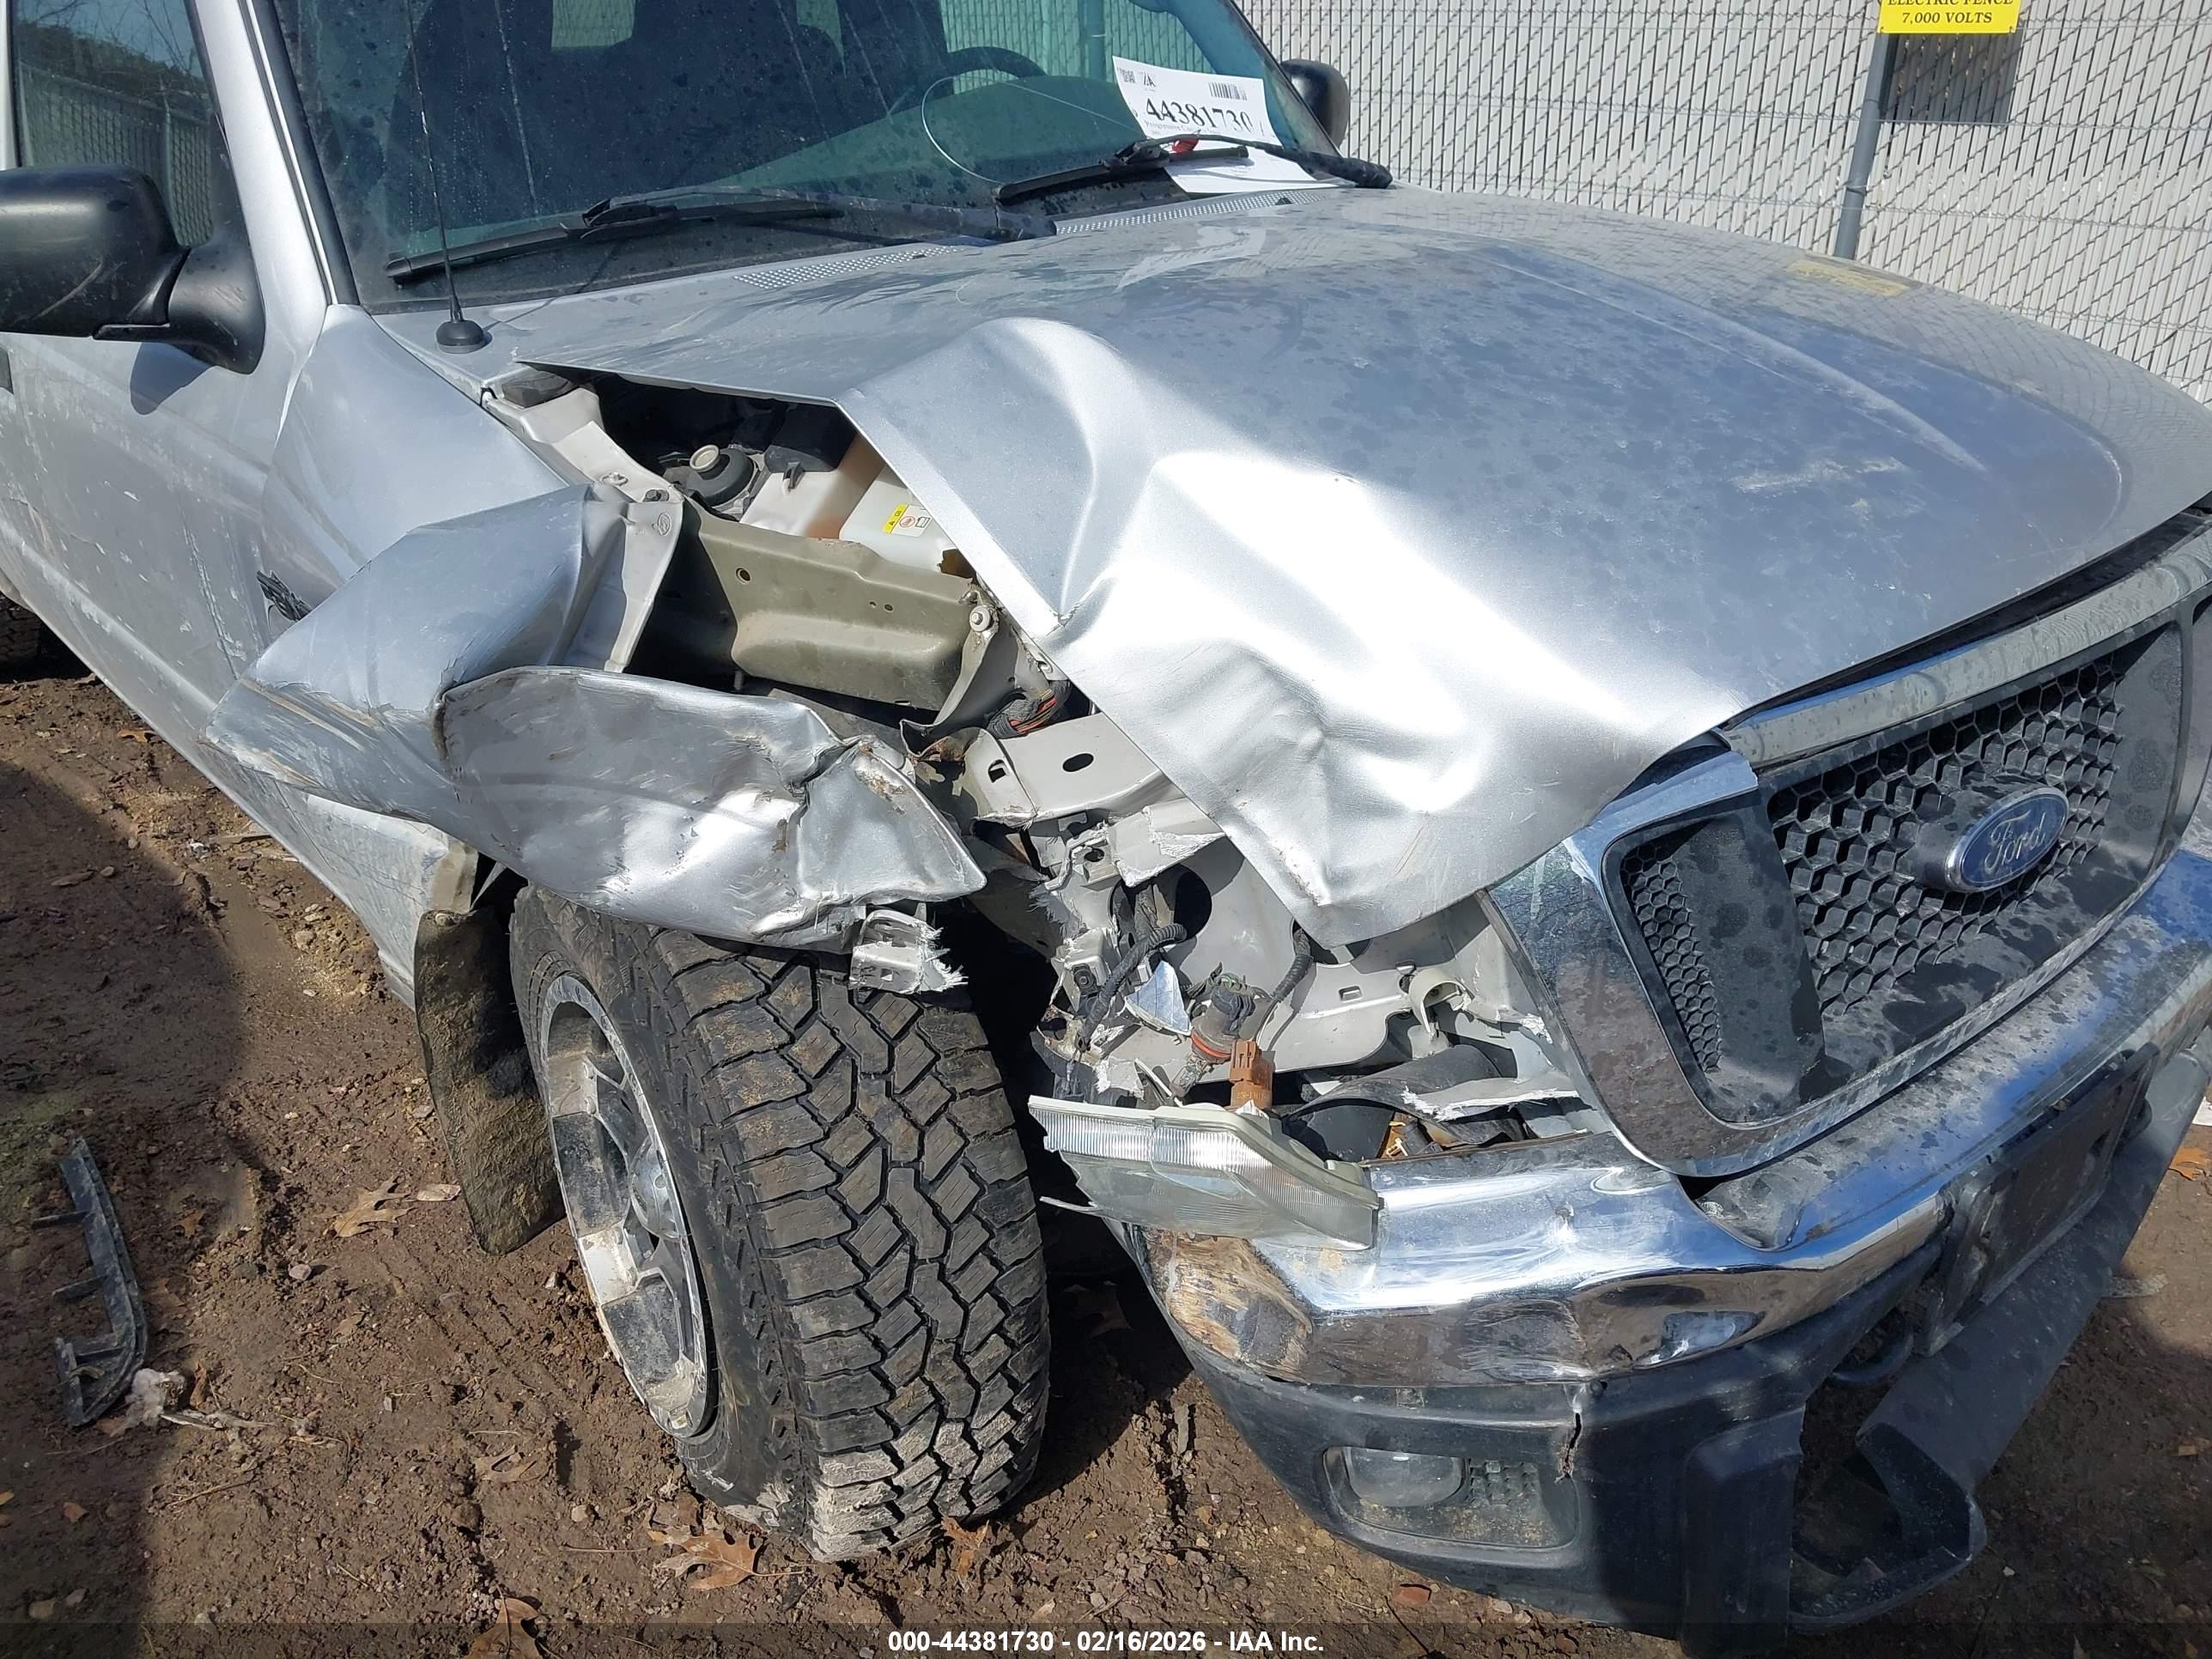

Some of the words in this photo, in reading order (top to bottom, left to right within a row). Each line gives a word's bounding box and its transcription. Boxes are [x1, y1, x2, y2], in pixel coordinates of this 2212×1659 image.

[1902, 12, 1941, 25] 7,000
[1945, 12, 1992, 23] VOLTS
[1146, 97, 1253, 132] 44381730
[1984, 810, 2047, 874] Ford
